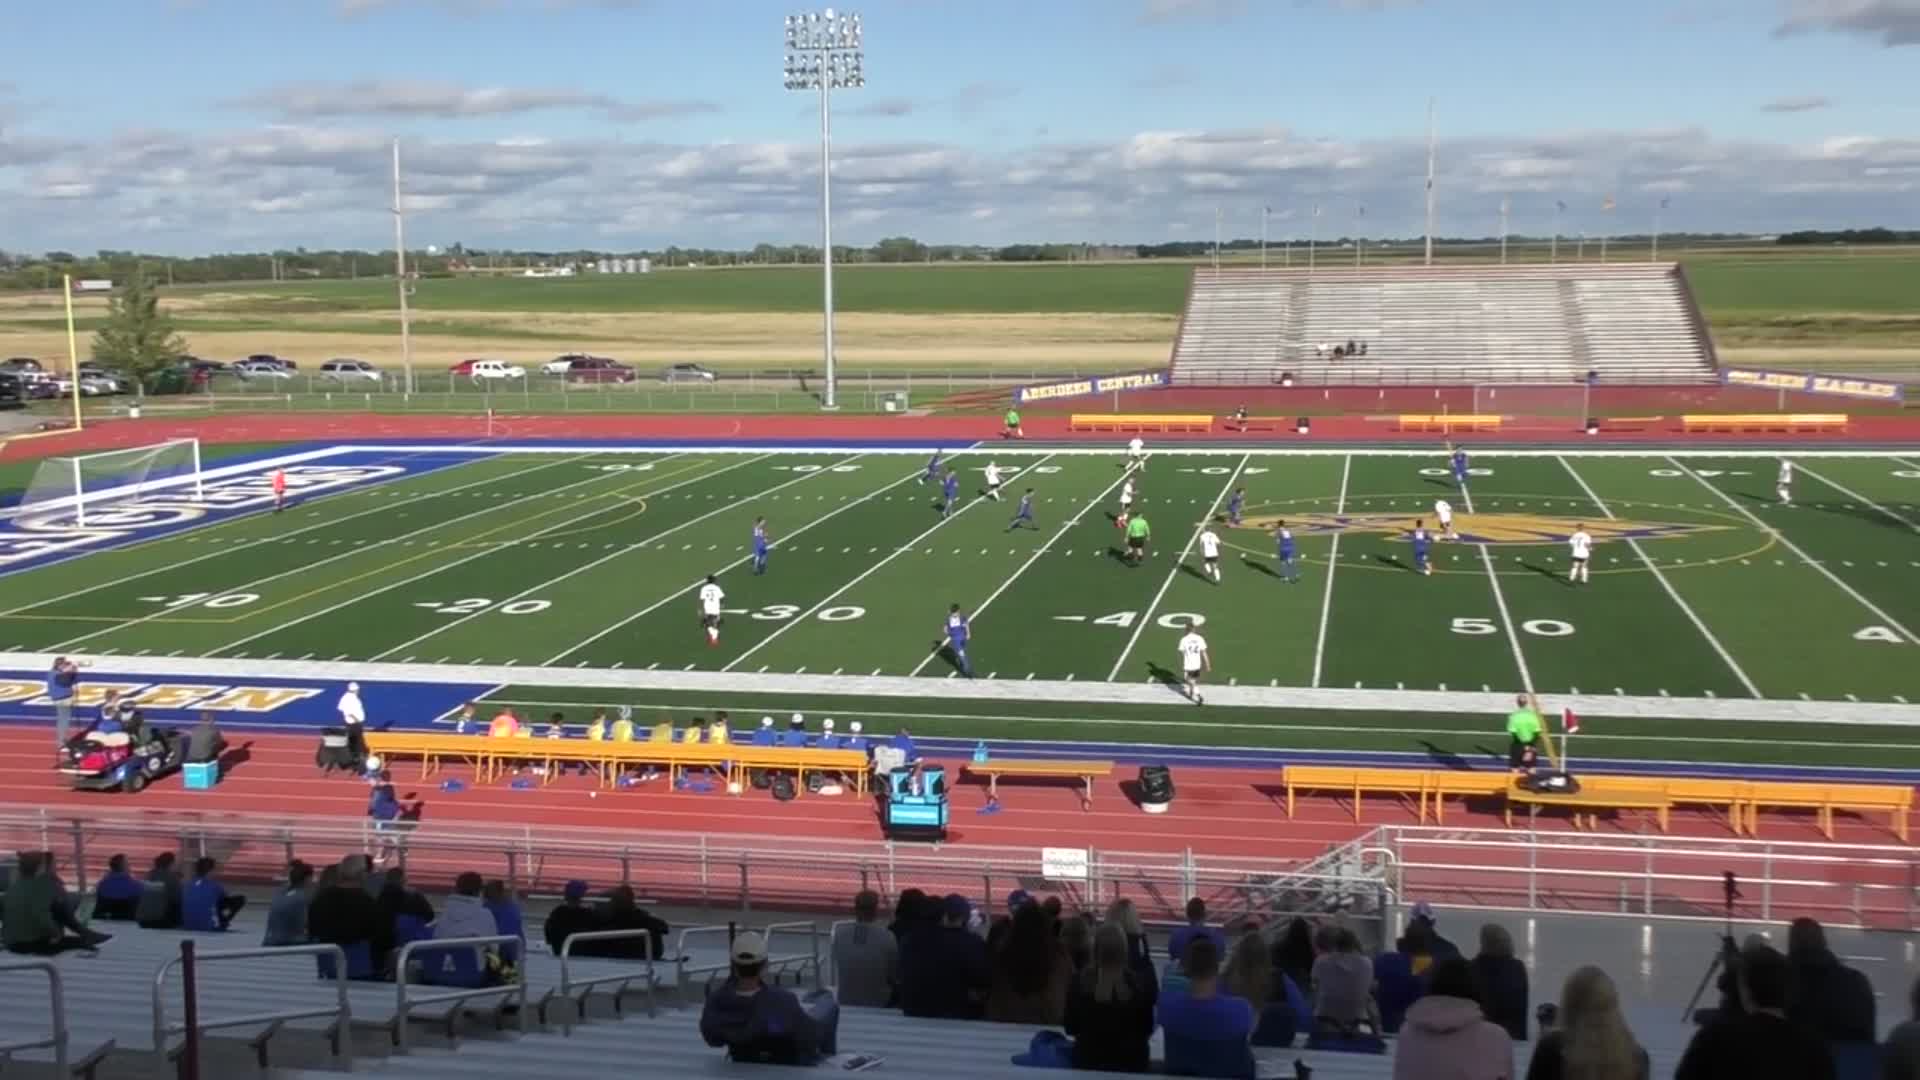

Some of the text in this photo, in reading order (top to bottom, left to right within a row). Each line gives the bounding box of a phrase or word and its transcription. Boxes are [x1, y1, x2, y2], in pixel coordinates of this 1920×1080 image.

[1021, 374, 1163, 400] ABERDEEN CENTRAL
[1450, 617, 1576, 636] 50
